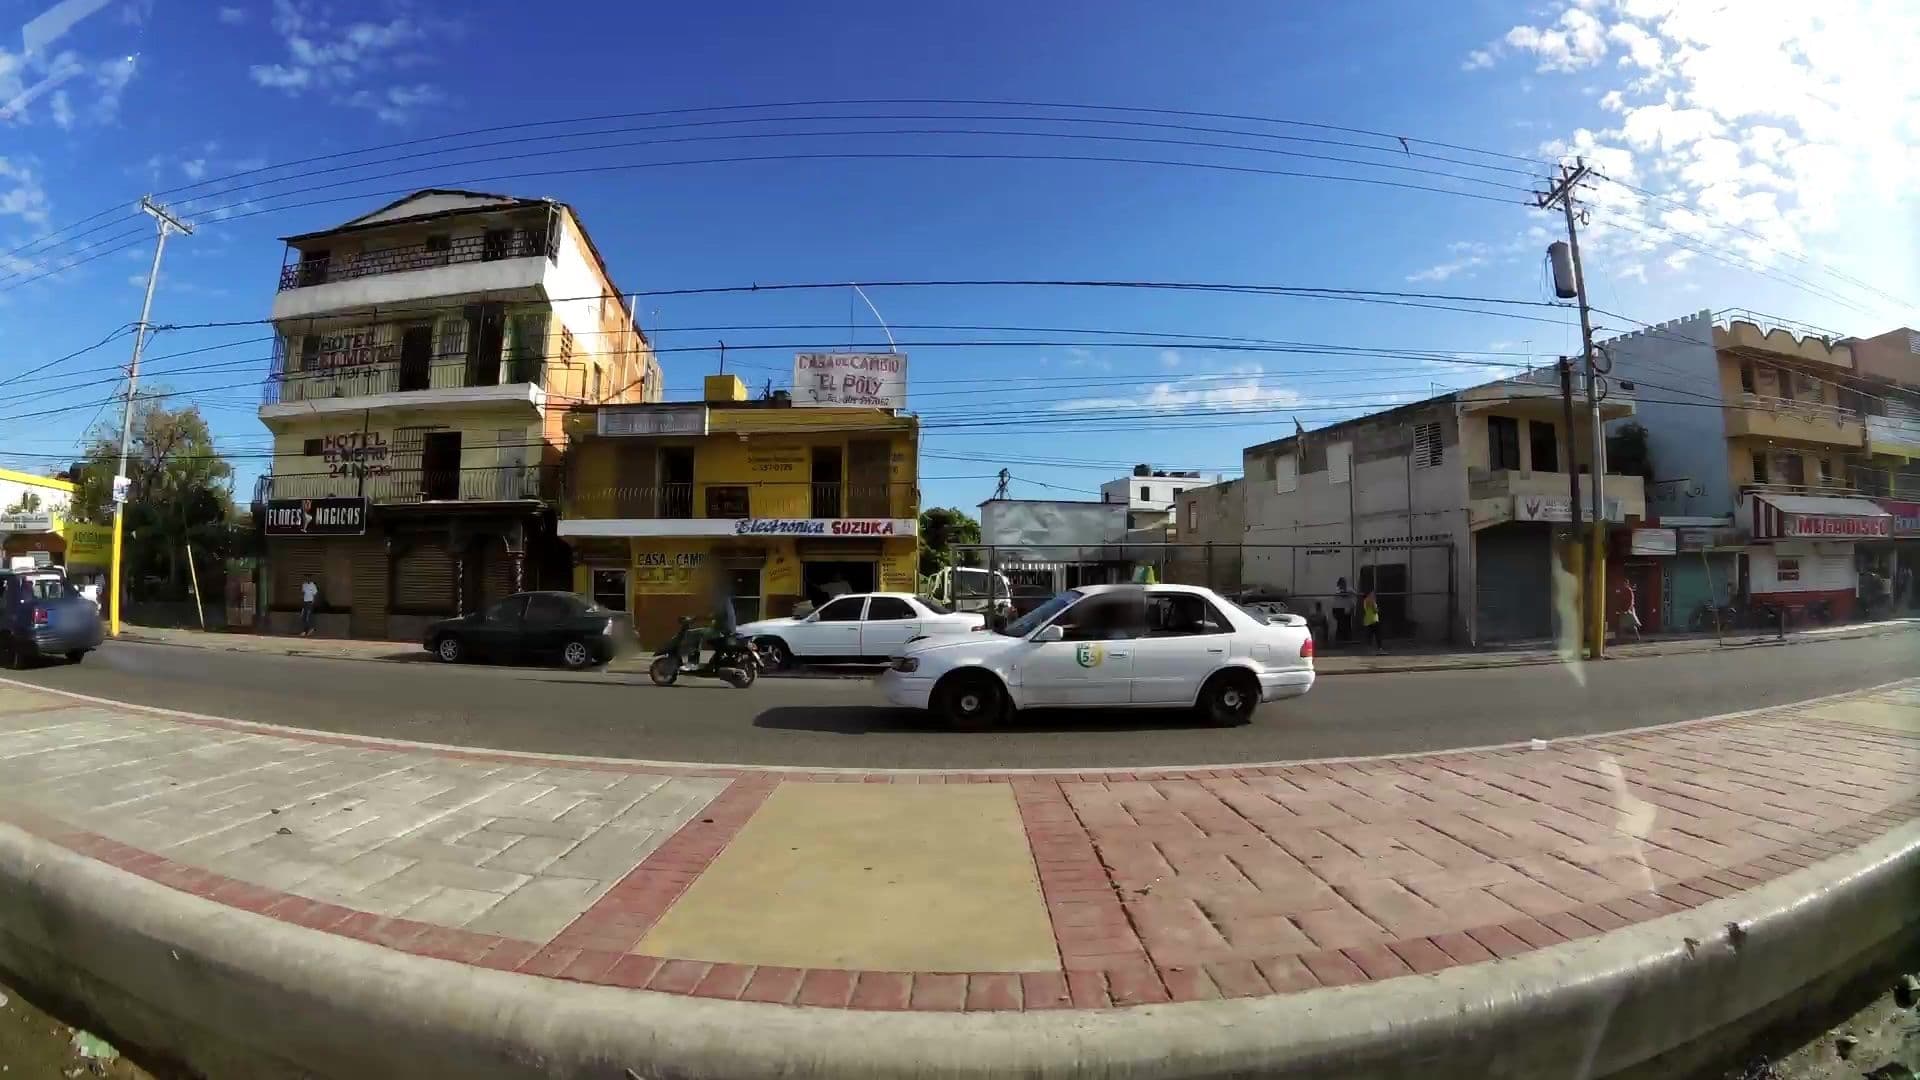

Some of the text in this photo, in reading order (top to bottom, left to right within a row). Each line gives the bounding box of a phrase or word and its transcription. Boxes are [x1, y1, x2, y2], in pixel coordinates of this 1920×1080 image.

[799, 355, 834, 369] CASA
[850, 355, 899, 373] CAMBIO
[843, 374, 883, 396] POLY
[324, 432, 387, 449] HOTEL
[315, 506, 361, 525] MAGICAS
[831, 520, 894, 535] SUZUKA
[639, 553, 666, 566] CASA
